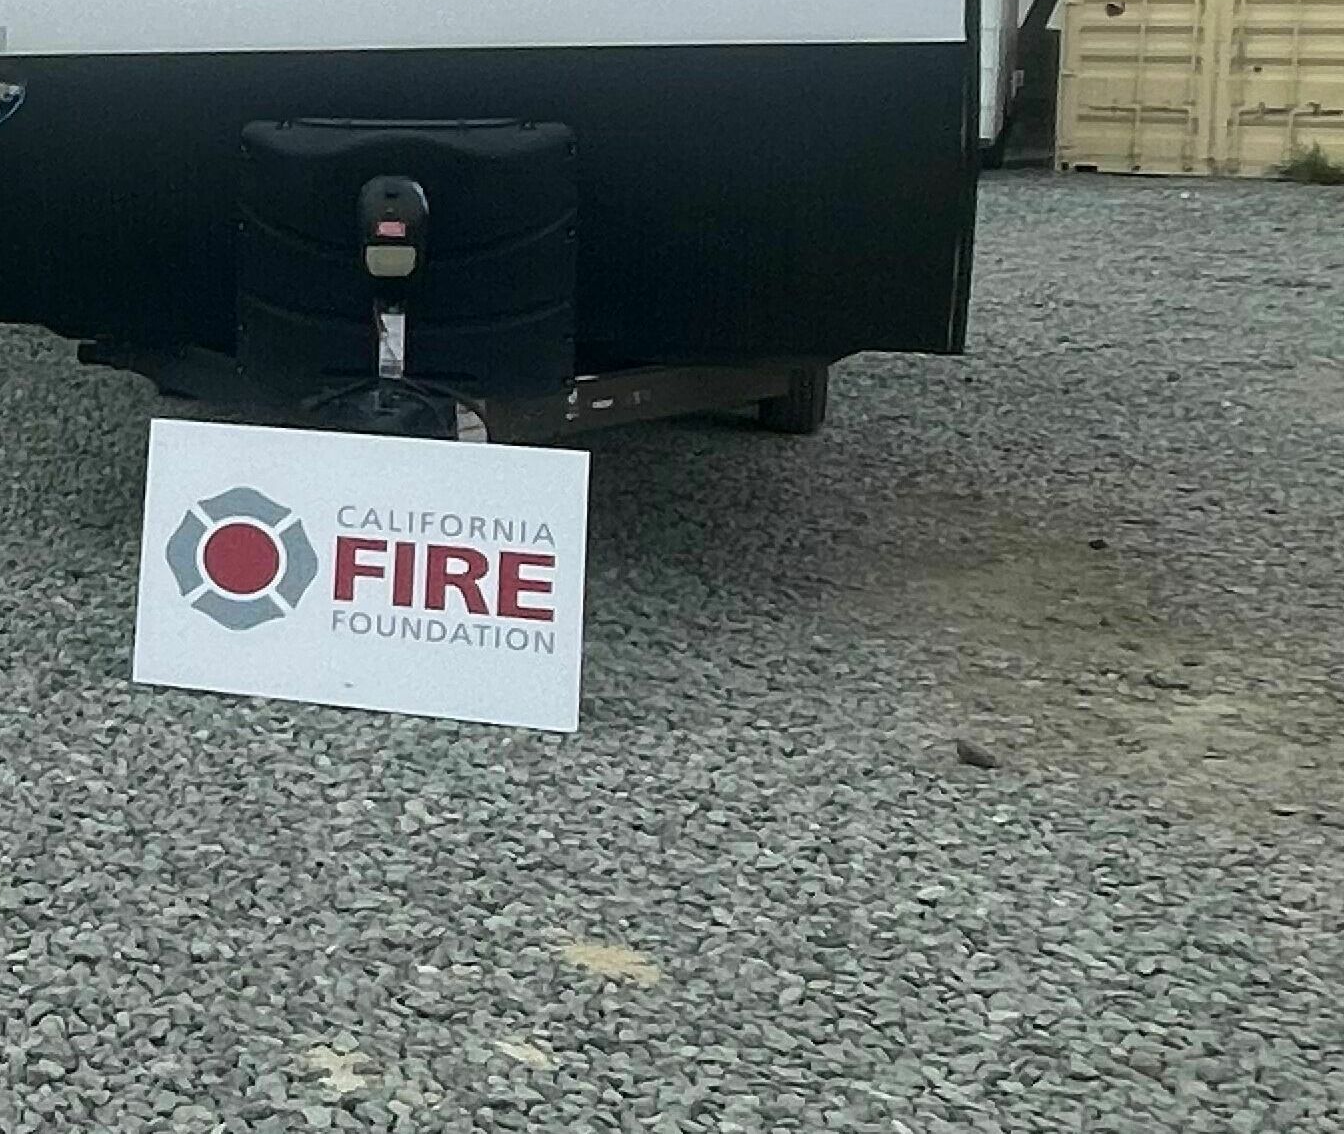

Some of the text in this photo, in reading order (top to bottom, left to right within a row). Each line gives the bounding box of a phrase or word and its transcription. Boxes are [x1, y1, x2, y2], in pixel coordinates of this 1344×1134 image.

[336, 505, 556, 547] CALIFORNIA
[333, 535, 556, 623] FIRE
[331, 609, 555, 655] FOUNDATION
